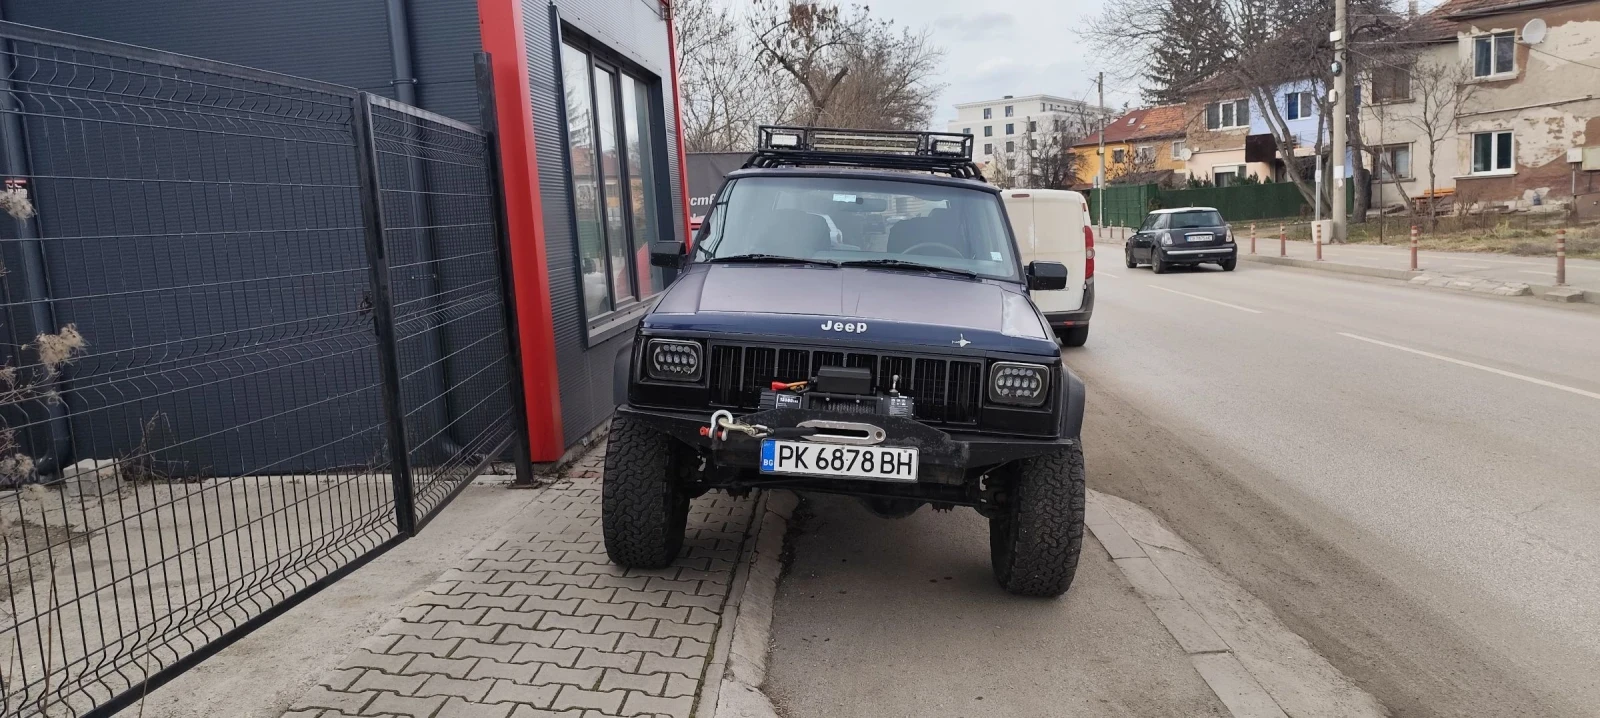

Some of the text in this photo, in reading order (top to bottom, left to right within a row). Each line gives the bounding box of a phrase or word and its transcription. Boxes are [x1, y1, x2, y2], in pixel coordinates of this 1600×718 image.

[820, 320, 868, 334] Jeep
[763, 445, 913, 476] BG PK 6878 BH
